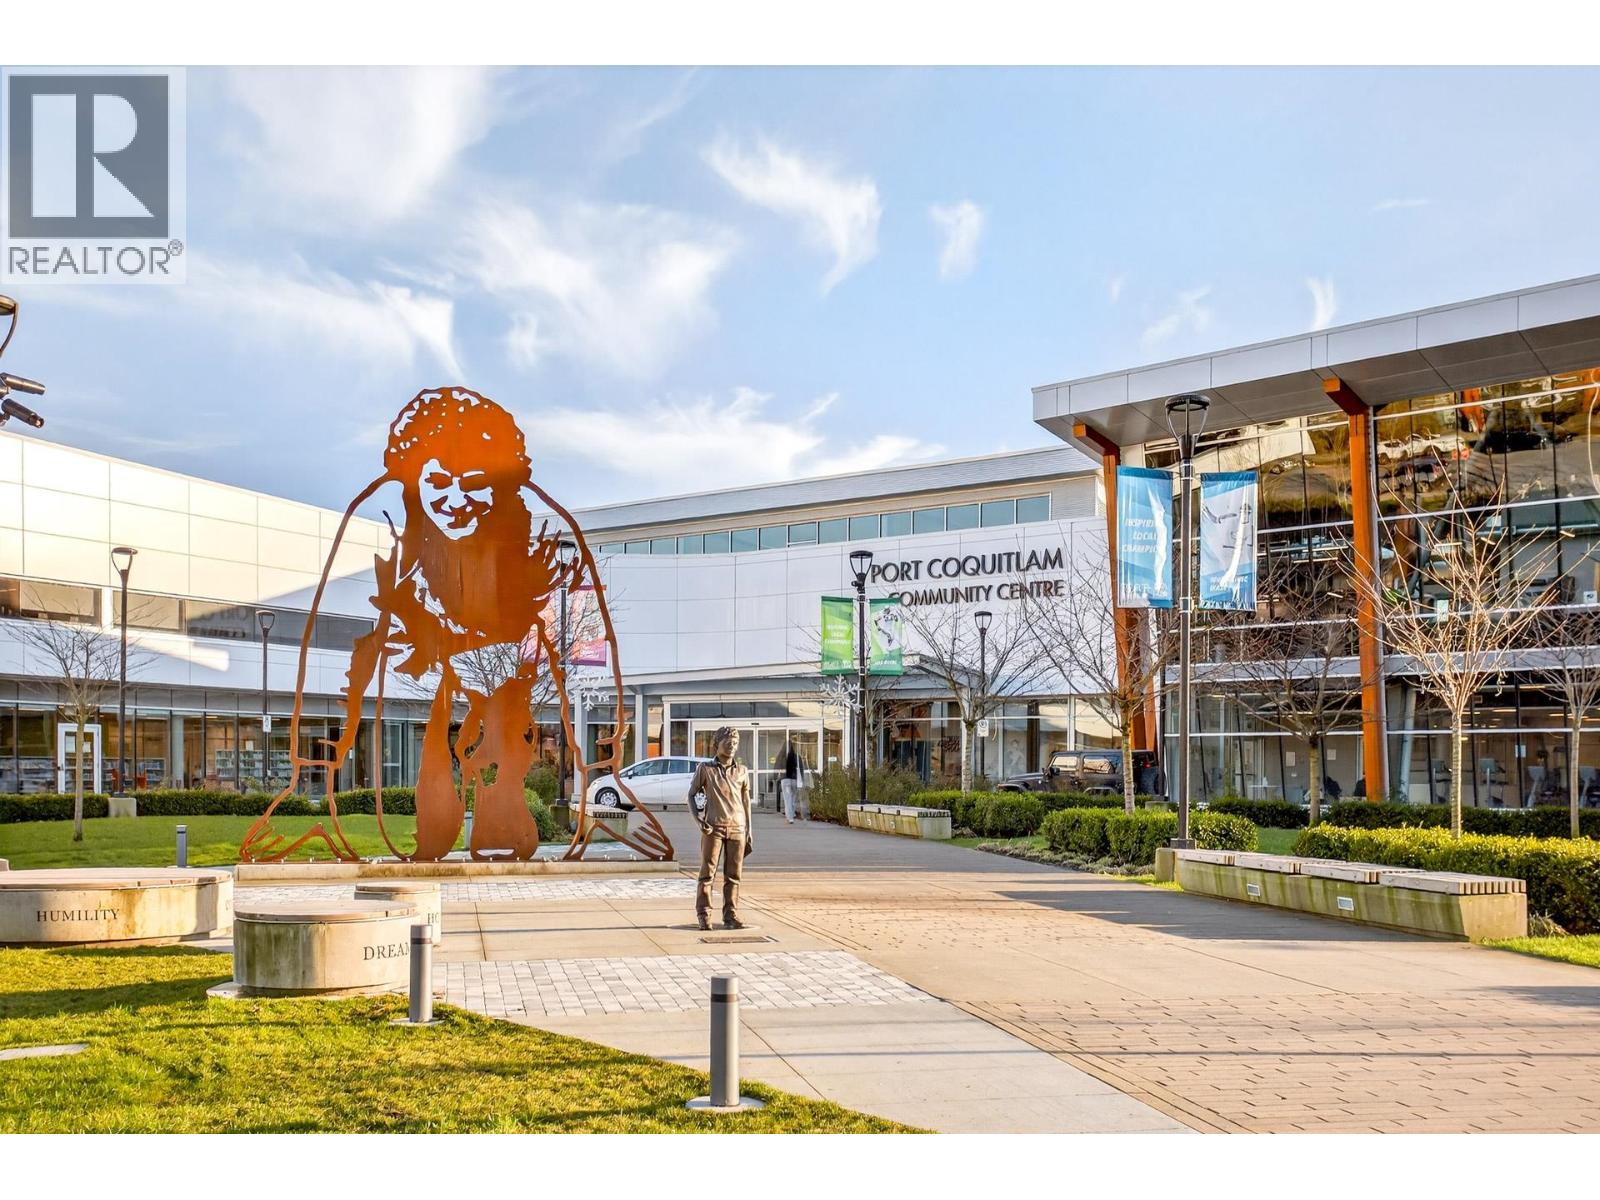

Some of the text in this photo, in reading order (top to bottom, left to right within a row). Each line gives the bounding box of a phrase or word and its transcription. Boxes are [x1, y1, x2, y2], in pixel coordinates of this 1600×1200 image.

[870, 547, 1064, 584] PORT COQUITLAM
[996, 580, 1065, 600] CENTRE
[36, 908, 120, 922] HUMILITY
